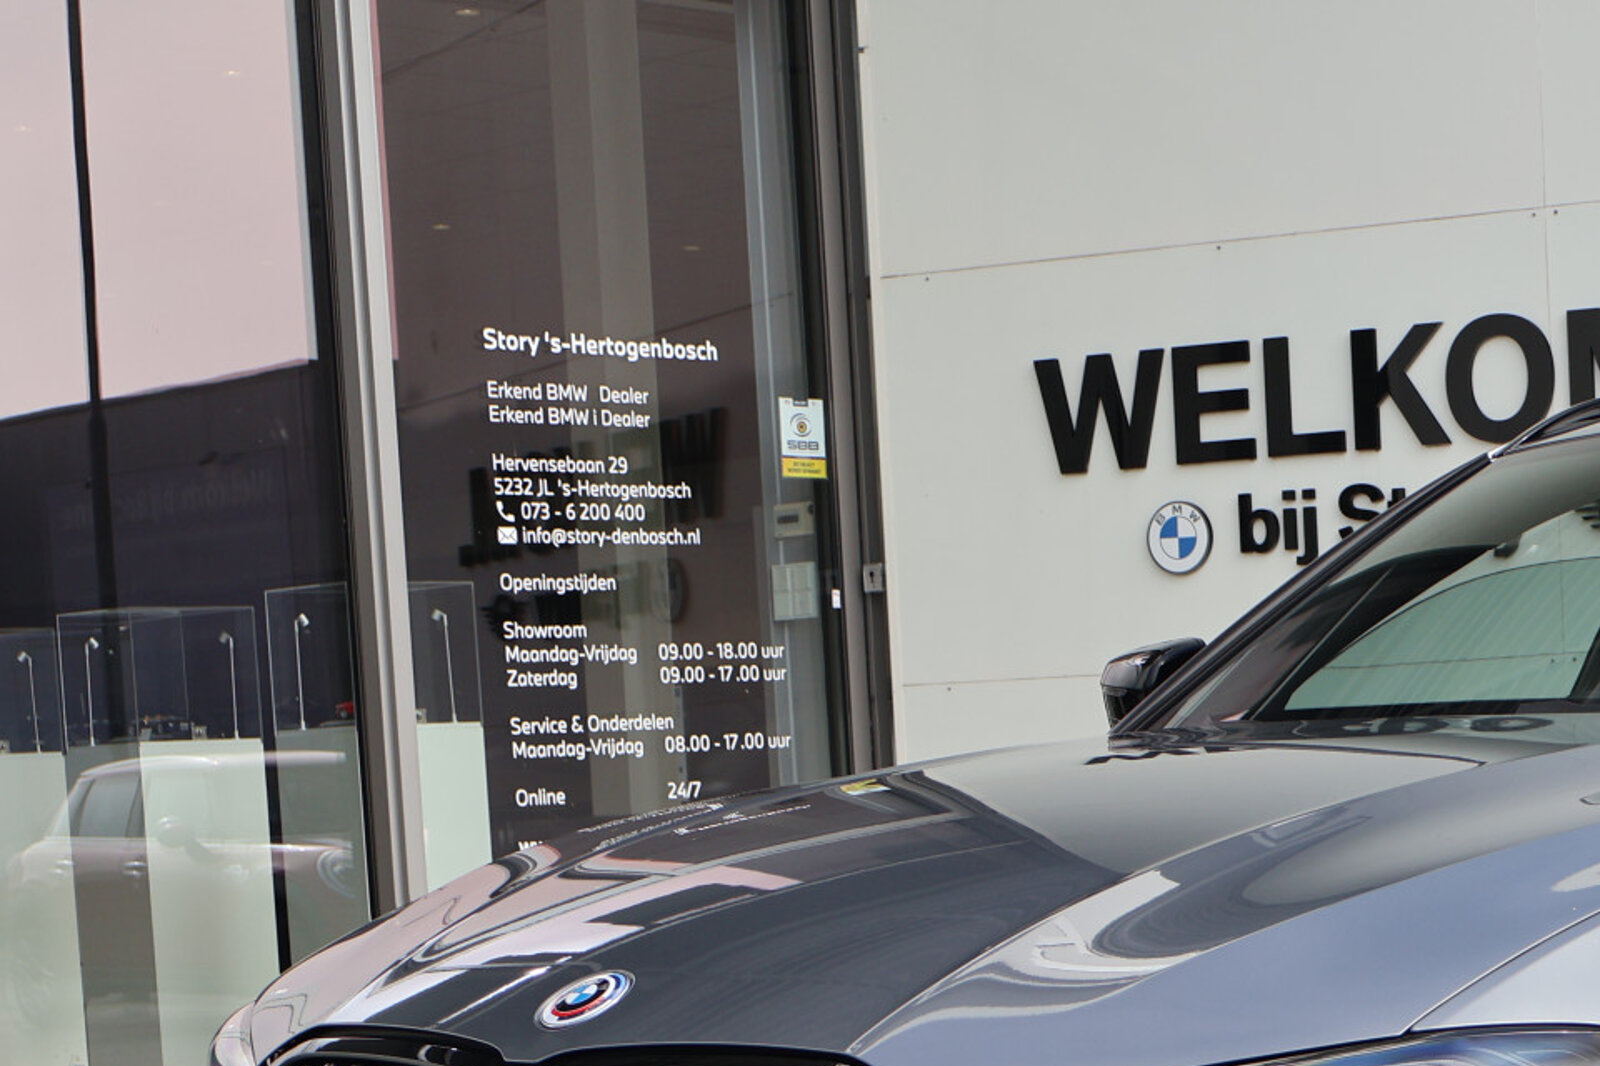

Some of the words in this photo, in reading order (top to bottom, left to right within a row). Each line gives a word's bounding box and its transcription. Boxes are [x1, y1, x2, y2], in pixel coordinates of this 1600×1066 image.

[482, 327, 540, 357] Story
[544, 331, 718, 363] 's-Hertogenbosch
[487, 380, 543, 401] Erkend
[546, 382, 588, 402] BMW
[599, 385, 649, 405] Dealer
[488, 404, 544, 424] Erkend
[547, 406, 590, 426] BMW
[592, 408, 598, 426] i
[600, 408, 651, 428] Dealer
[492, 453, 606, 474] Hervensebaan
[608, 456, 628, 475] 29
[494, 477, 534, 496] 5232
[536, 478, 555, 498] JL
[557, 479, 692, 502] 's-Hertogenbosch
[521, 501, 551, 521] 073
[565, 502, 576, 521] 6
[579, 502, 611, 521] 200
[614, 503, 646, 521] 400
[522, 526, 701, 548] info@story-denbosch.nl
[1237, 488, 1319, 566] bij
[1338, 483, 1408, 540] S
[499, 572, 617, 595] Openingstijden
[503, 621, 588, 639] Showroom
[505, 643, 638, 666] Maandag-Vrijdag
[658, 642, 704, 661] 09.00
[716, 641, 758, 660] 18.00
[761, 645, 785, 659] uur
[506, 668, 578, 690] Zaterdag
[659, 665, 705, 684] 09.00
[763, 668, 788, 682] uur
[509, 716, 568, 736] Service
[571, 715, 584, 734] &
[587, 712, 675, 733] Onderdelen
[512, 738, 645, 761] Maandag-Vrijdag
[664, 734, 711, 754] 08.00
[767, 735, 793, 749] uur
[515, 788, 566, 807] Online
[667, 780, 702, 800] 24/7
